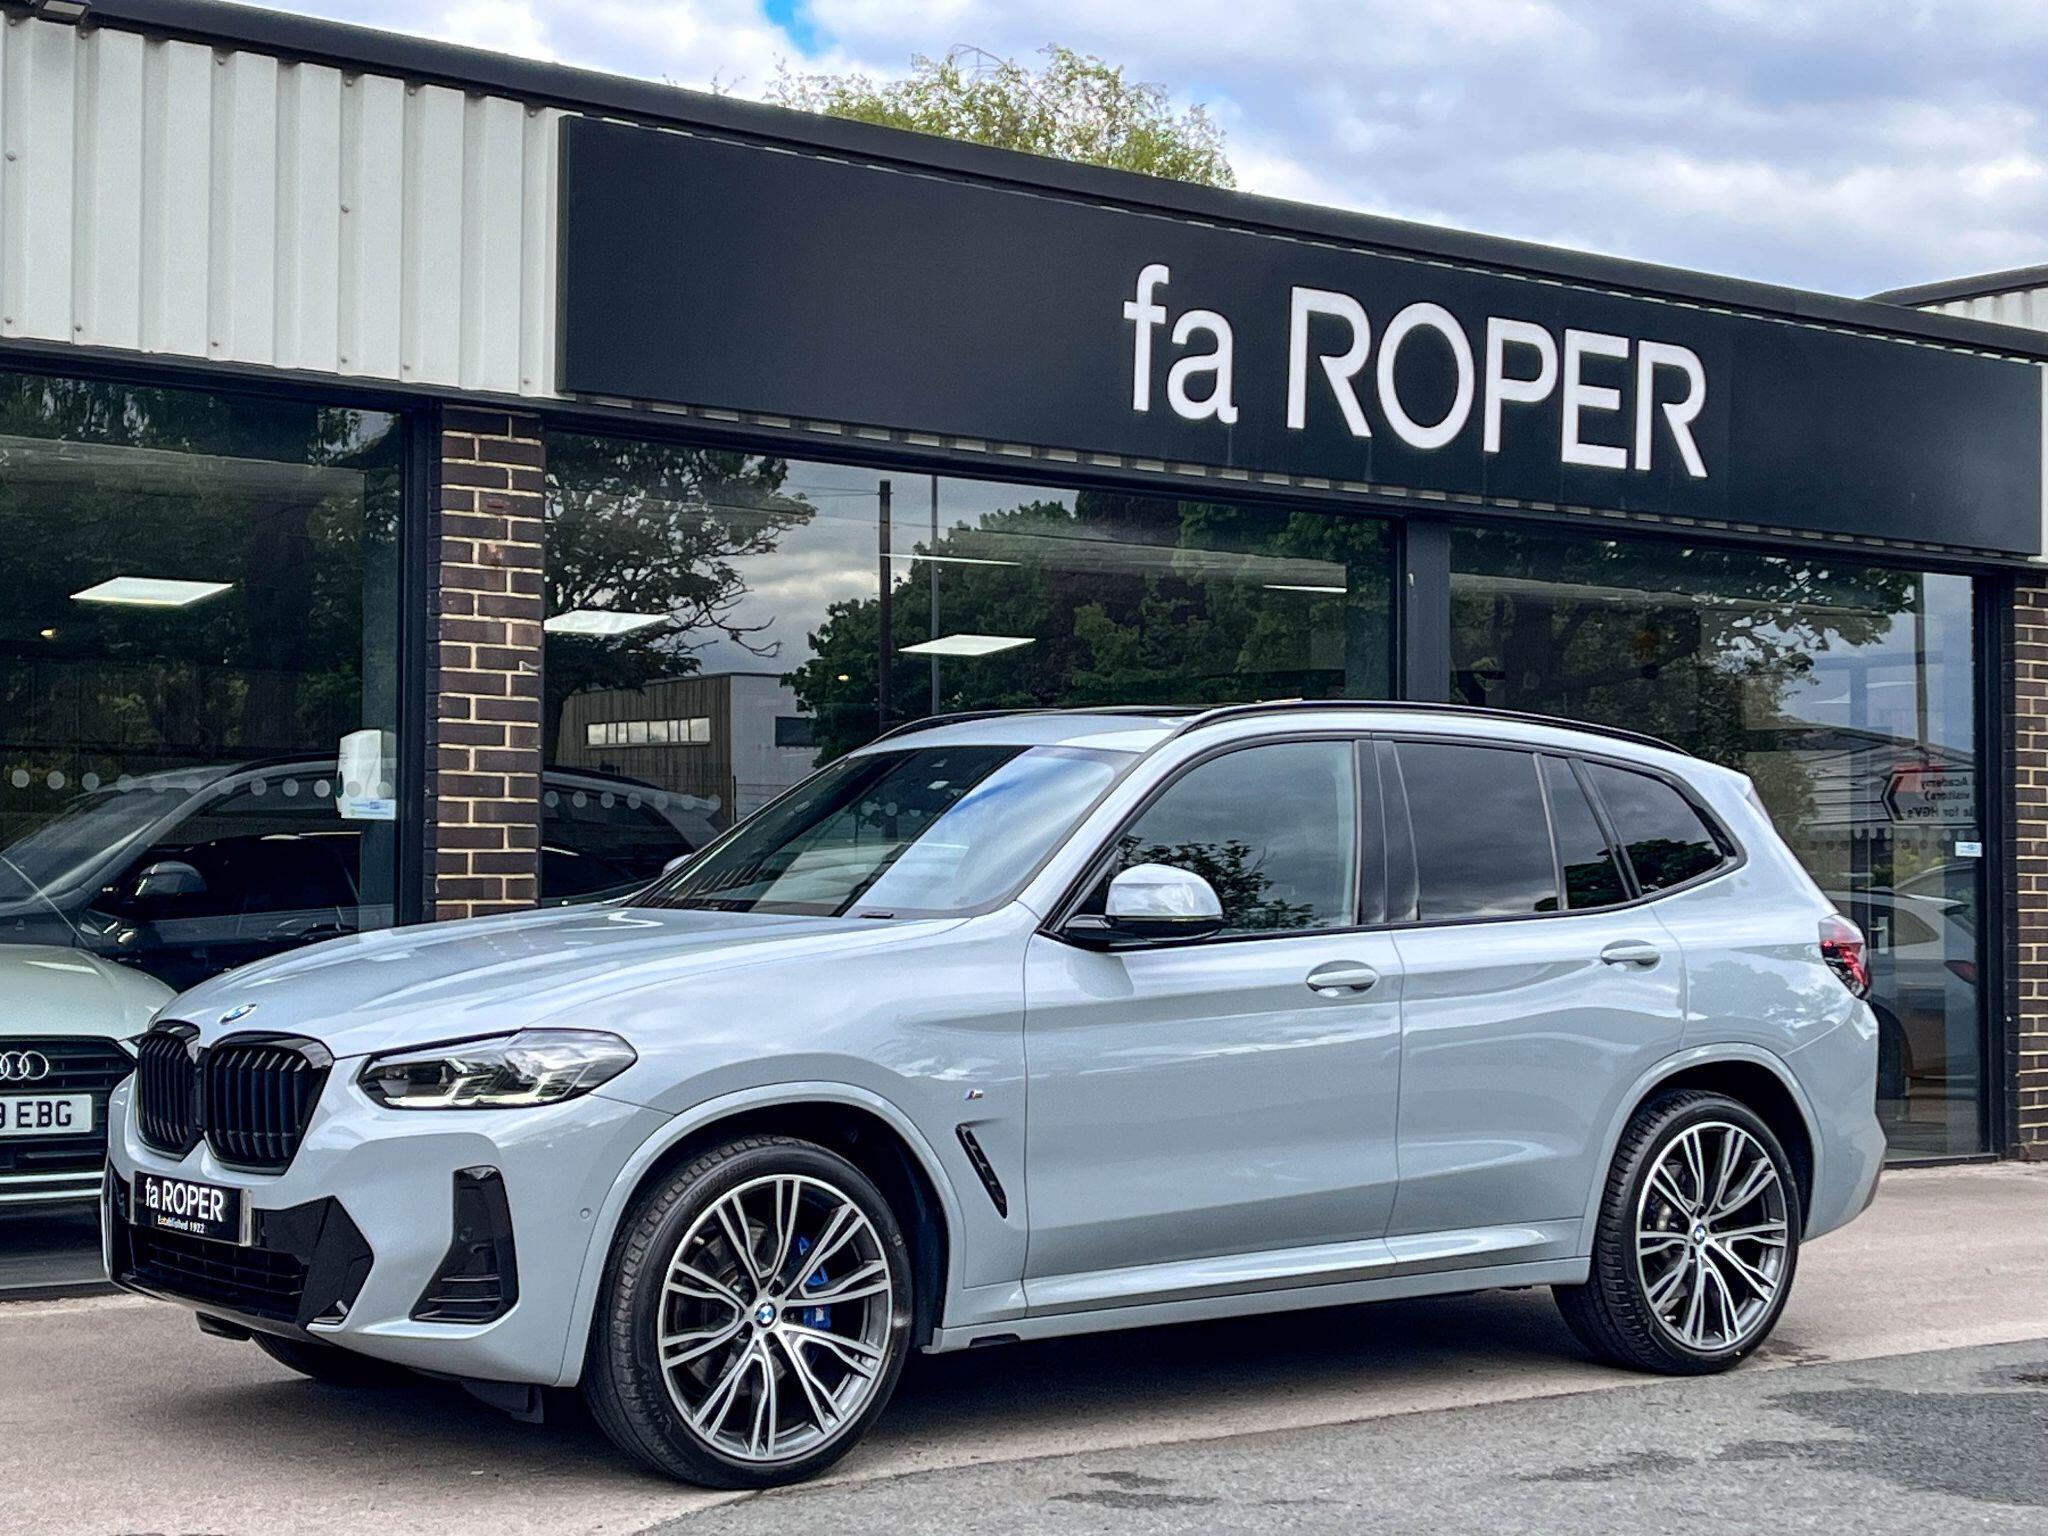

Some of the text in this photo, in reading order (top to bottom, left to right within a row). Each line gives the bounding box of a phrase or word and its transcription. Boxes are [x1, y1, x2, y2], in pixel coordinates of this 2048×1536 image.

[1123, 263, 1708, 478] fa ROPER
[16, 1100, 72, 1128] EBG
[145, 1177, 224, 1222] fa ROPER
[189, 1221, 206, 1234] 1922
